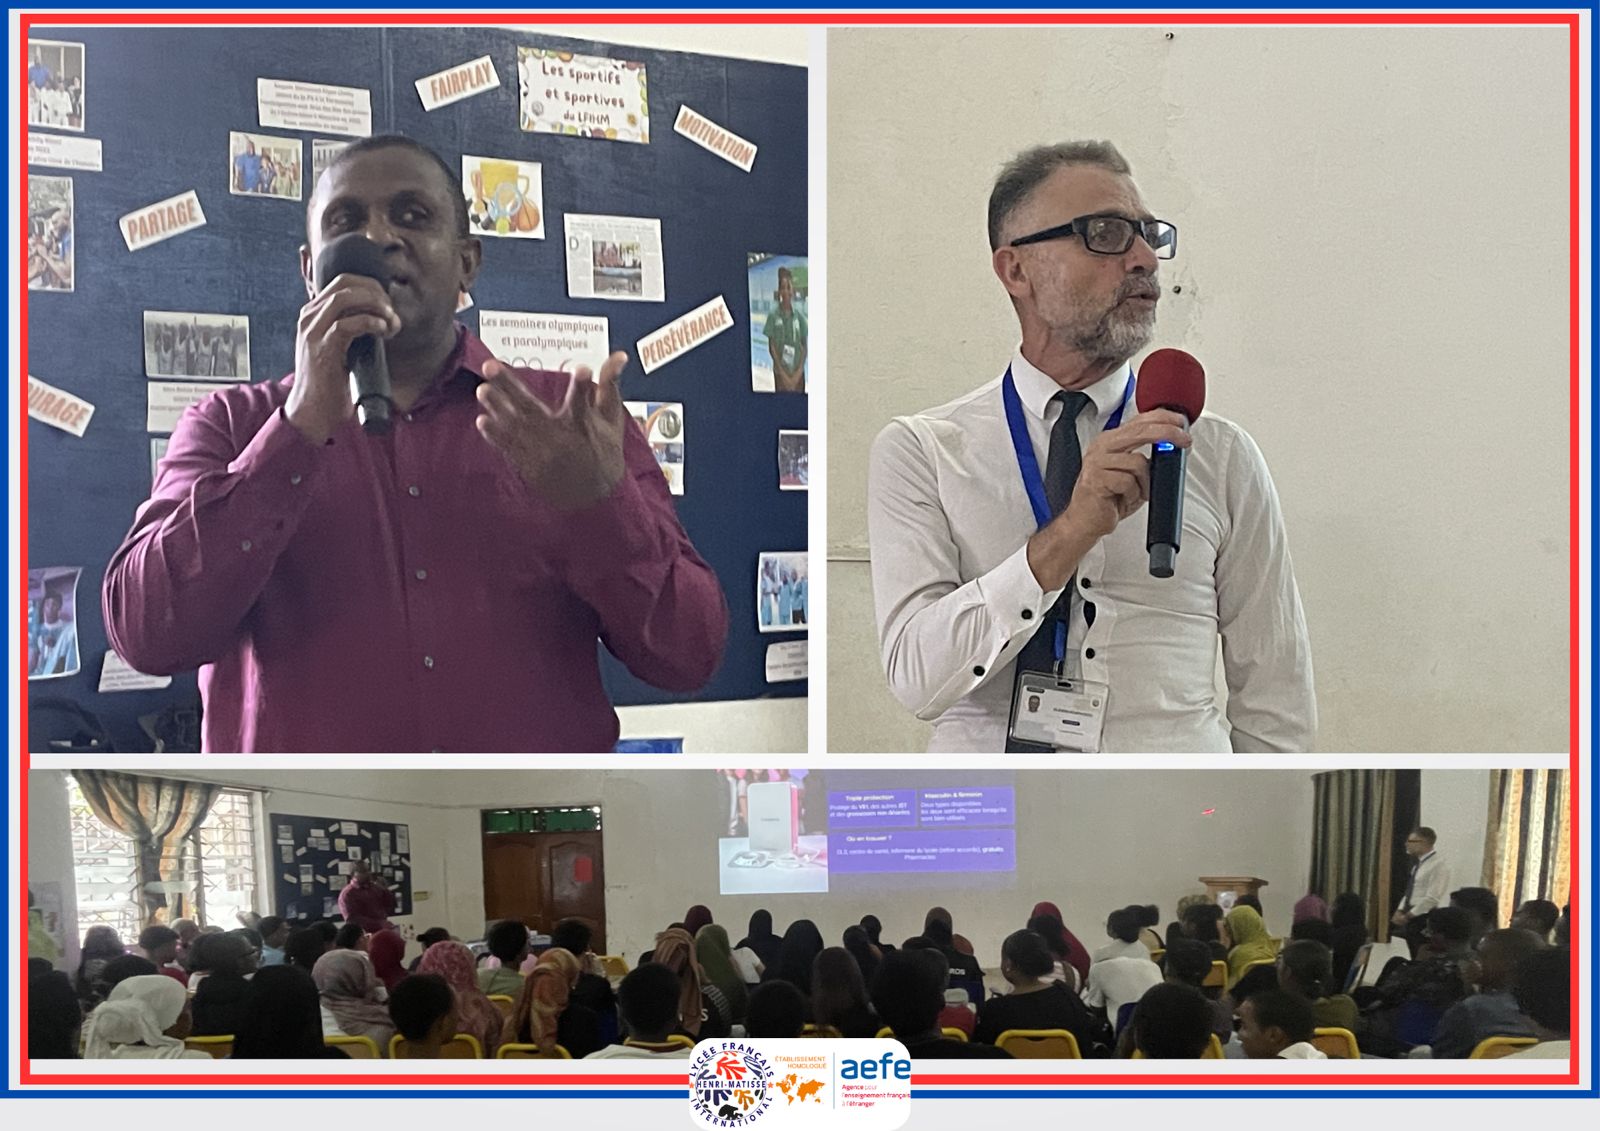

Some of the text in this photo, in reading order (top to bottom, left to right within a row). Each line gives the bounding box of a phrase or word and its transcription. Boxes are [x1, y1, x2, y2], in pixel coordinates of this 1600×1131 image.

[430, 61, 492, 103] FAIRPLAY
[542, 60, 621, 85] Les sportifs
[545, 88, 625, 108] et sportives
[563, 110, 575, 121] du
[677, 110, 754, 166] MOTIVATION
[127, 198, 198, 244] PARTAGE
[481, 316, 604, 335] Les semaines olympiques
[502, 336, 589, 352] et paralympiques
